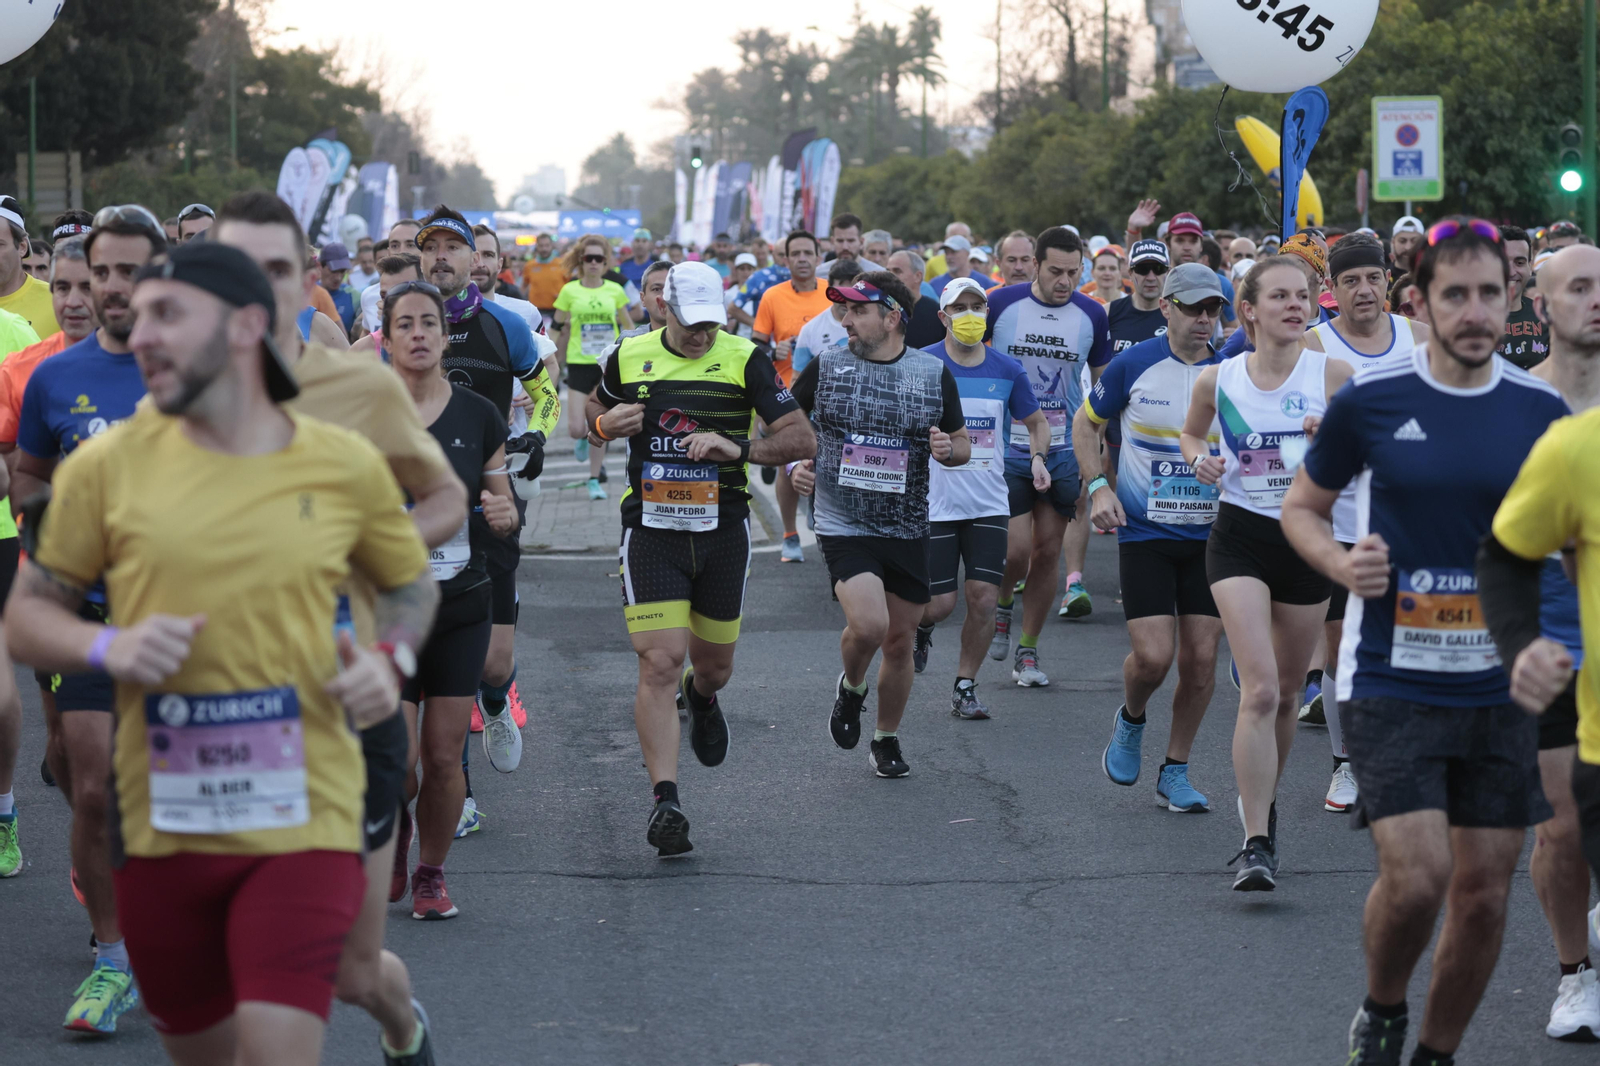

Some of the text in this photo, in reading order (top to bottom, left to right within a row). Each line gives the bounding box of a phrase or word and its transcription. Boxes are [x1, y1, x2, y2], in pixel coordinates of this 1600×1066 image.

[1135, 243, 1163, 253] FRANCE
[1025, 334, 1068, 348] ISABEL
[1515, 341, 1527, 354] of
[1007, 345, 1080, 363] FERNANDEZ
[866, 435, 903, 447] ZURICH
[864, 455, 888, 467] 5987
[666, 468, 709, 478] ZURICH
[842, 467, 904, 481] PIZARRO CIDONC
[667, 490, 692, 500] 4255
[1171, 486, 1201, 496] 11105
[654, 505, 706, 515] JUAN PEDRO
[1155, 501, 1213, 511] NUNO PAISANA
[636, 612, 664, 620] BENITO
[1436, 609, 1473, 623] 4541
[1404, 631, 1442, 645] DAVID
[193, 694, 284, 723] ZURICH
